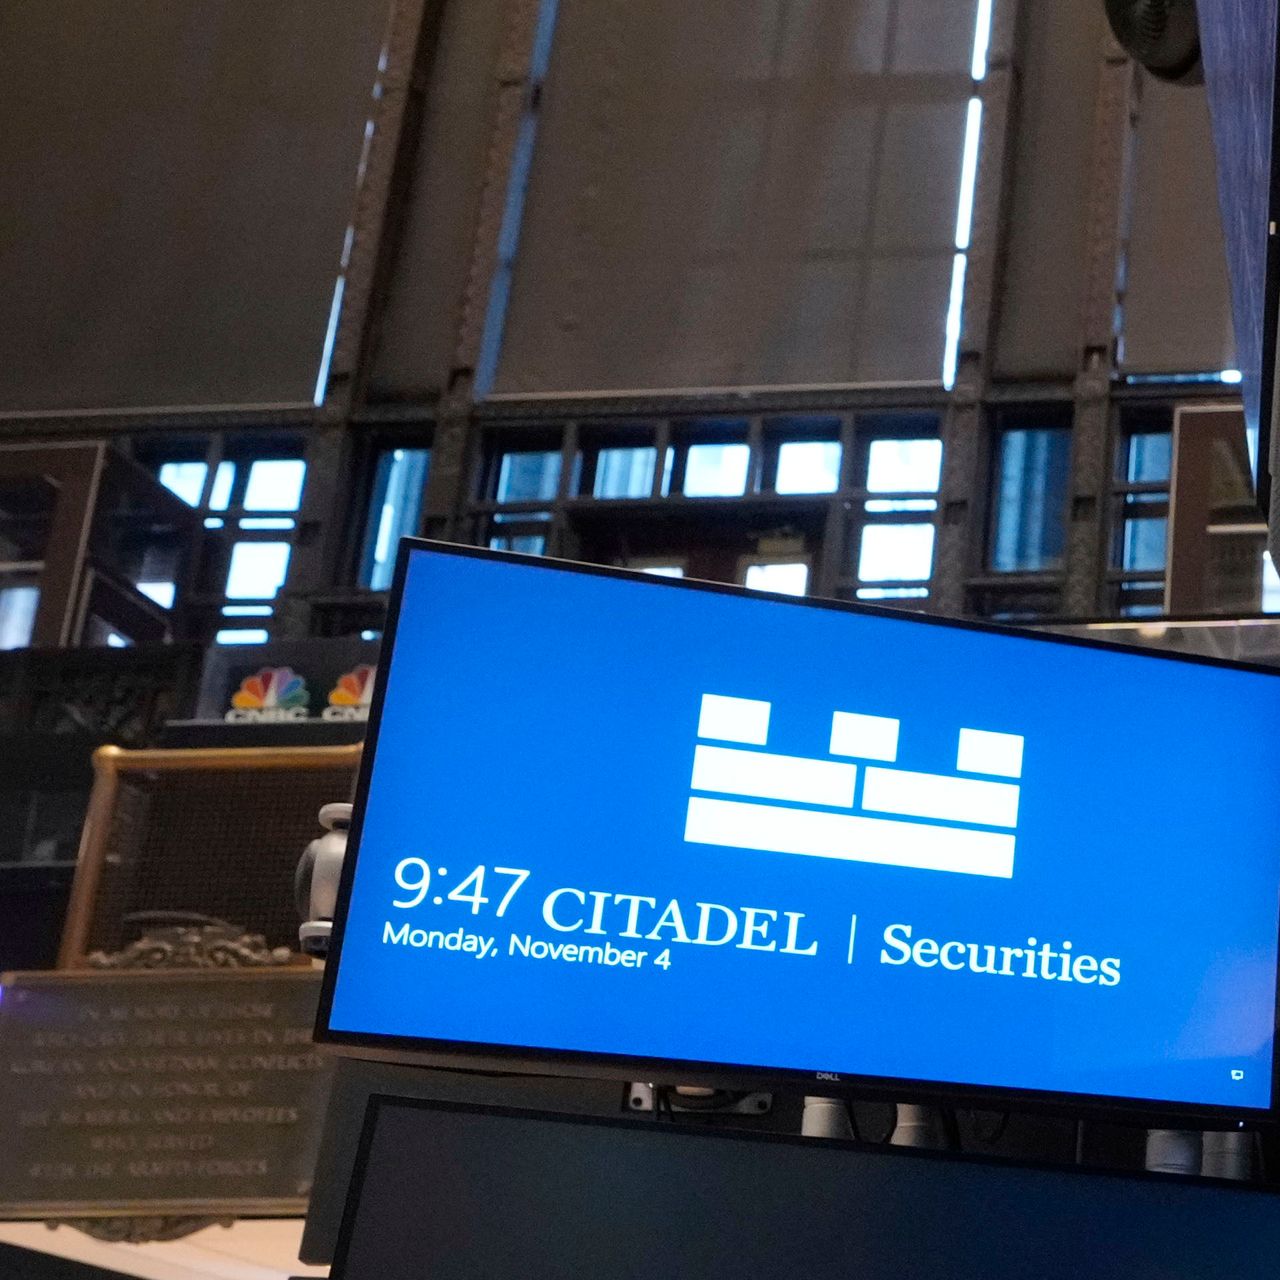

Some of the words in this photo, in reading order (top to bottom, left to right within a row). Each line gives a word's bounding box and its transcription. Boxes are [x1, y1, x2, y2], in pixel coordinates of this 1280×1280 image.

[224, 707, 309, 723] CNBC
[321, 705, 370, 722] CN
[393, 856, 531, 917] 9:47
[382, 920, 498, 959] Monday,
[508, 934, 647, 968] November
[654, 948, 672, 970] 4
[542, 887, 818, 956] CITADEL
[880, 923, 1121, 987] Securities
[816, 1072, 840, 1082] DELL
